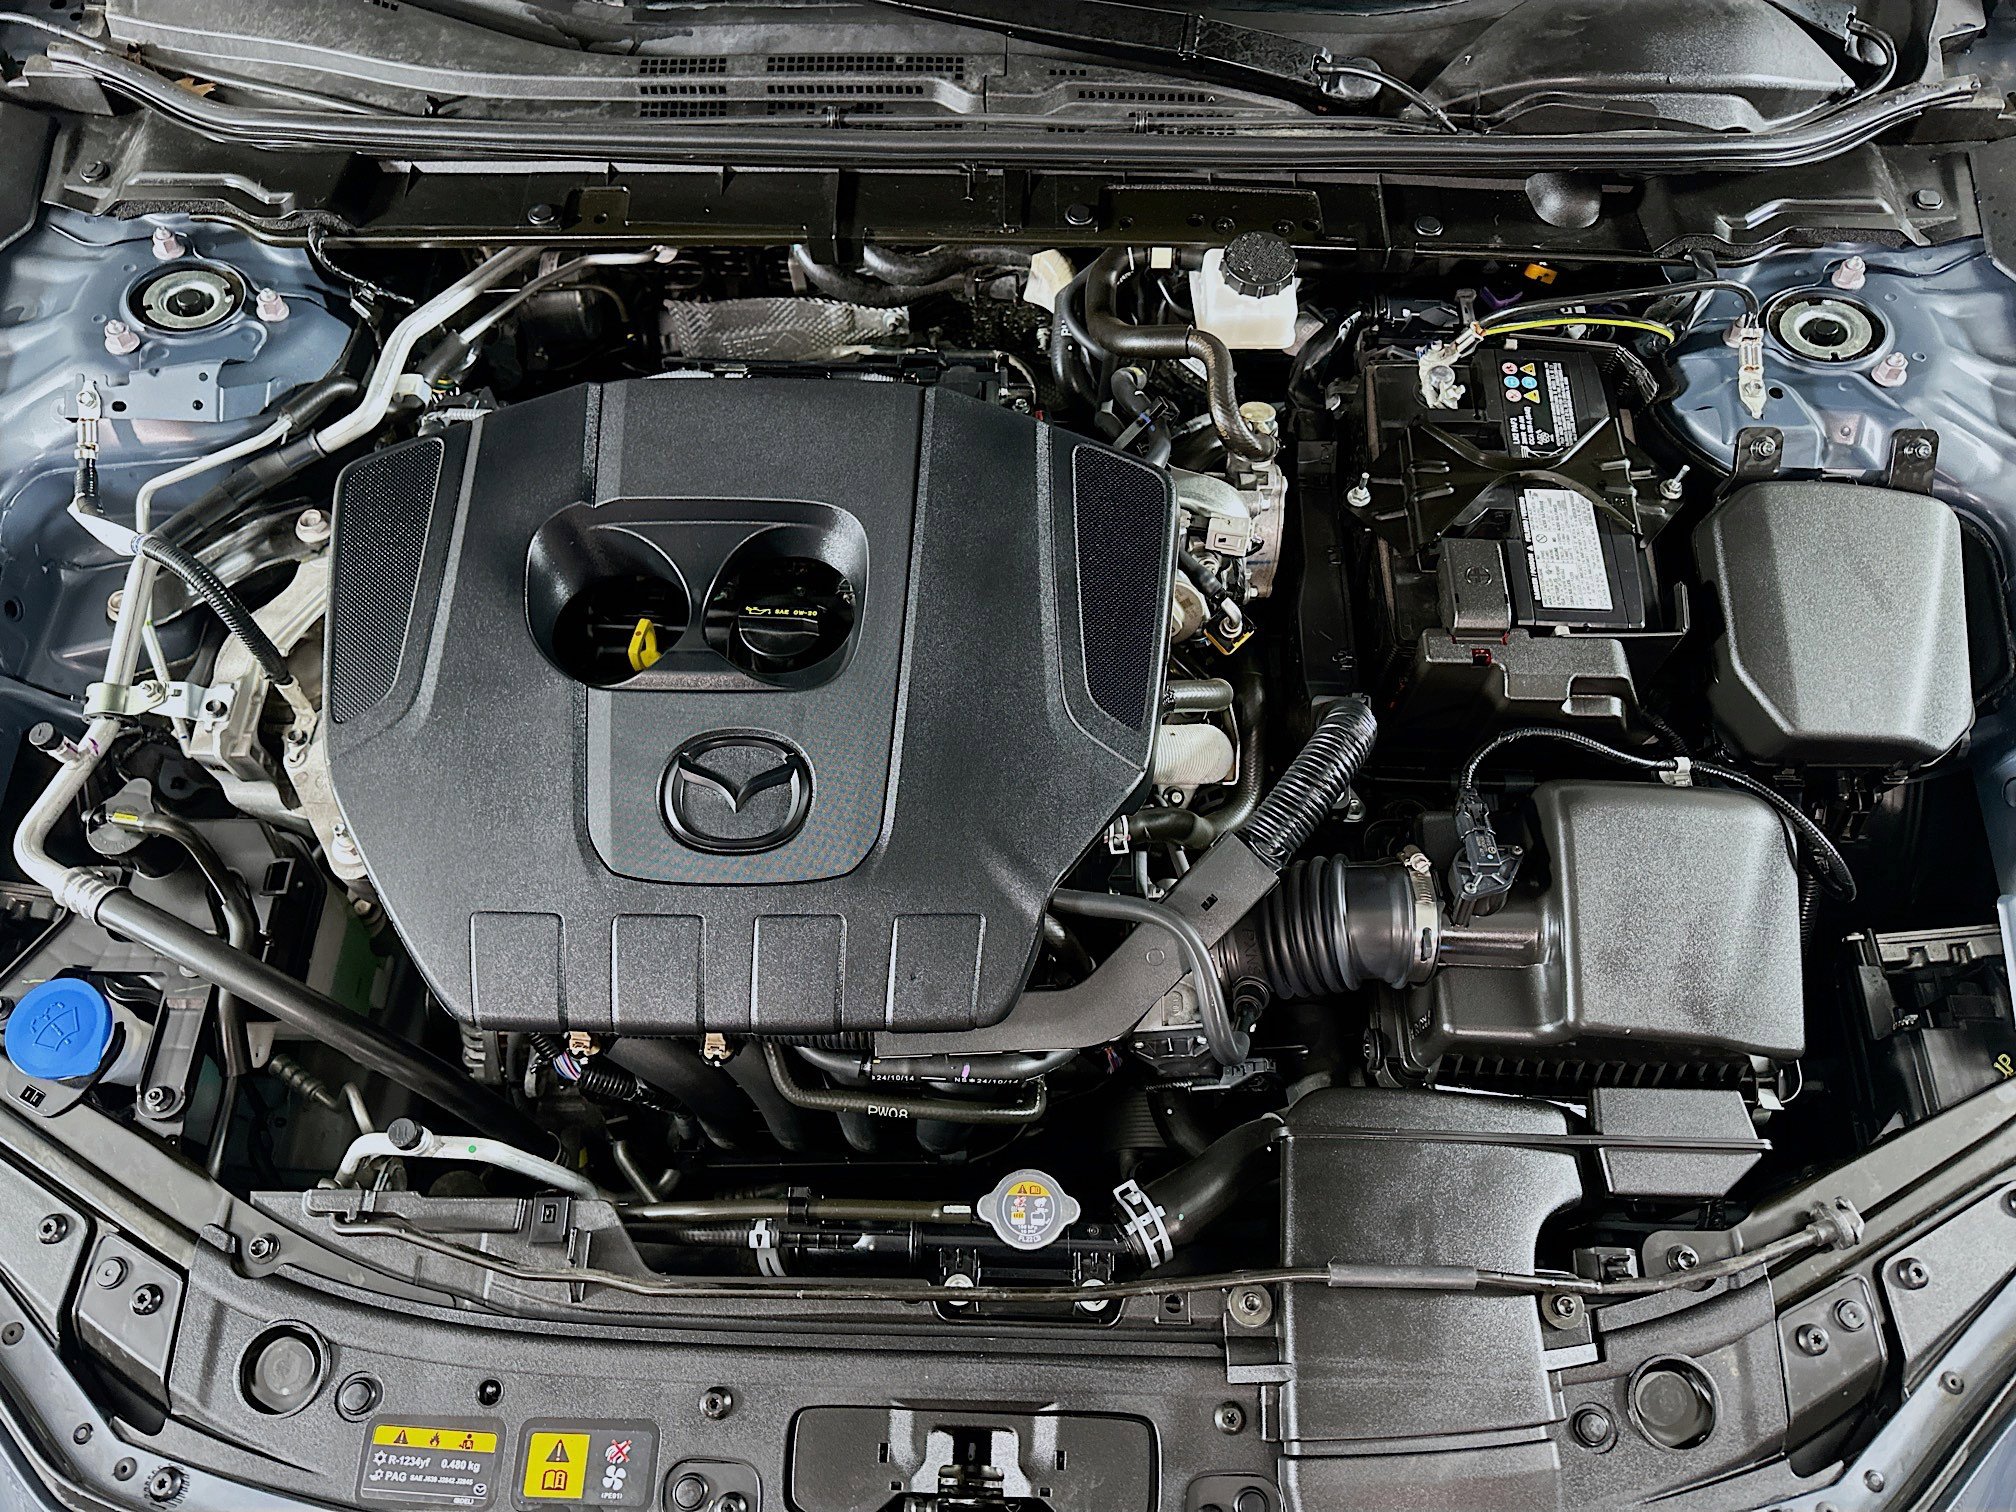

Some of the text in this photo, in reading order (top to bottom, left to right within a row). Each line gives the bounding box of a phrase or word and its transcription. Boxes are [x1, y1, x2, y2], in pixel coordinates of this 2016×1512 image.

[387, 1455, 481, 1473] R-1234yf 0.480 kg
[384, 1470, 407, 1482] PAG
